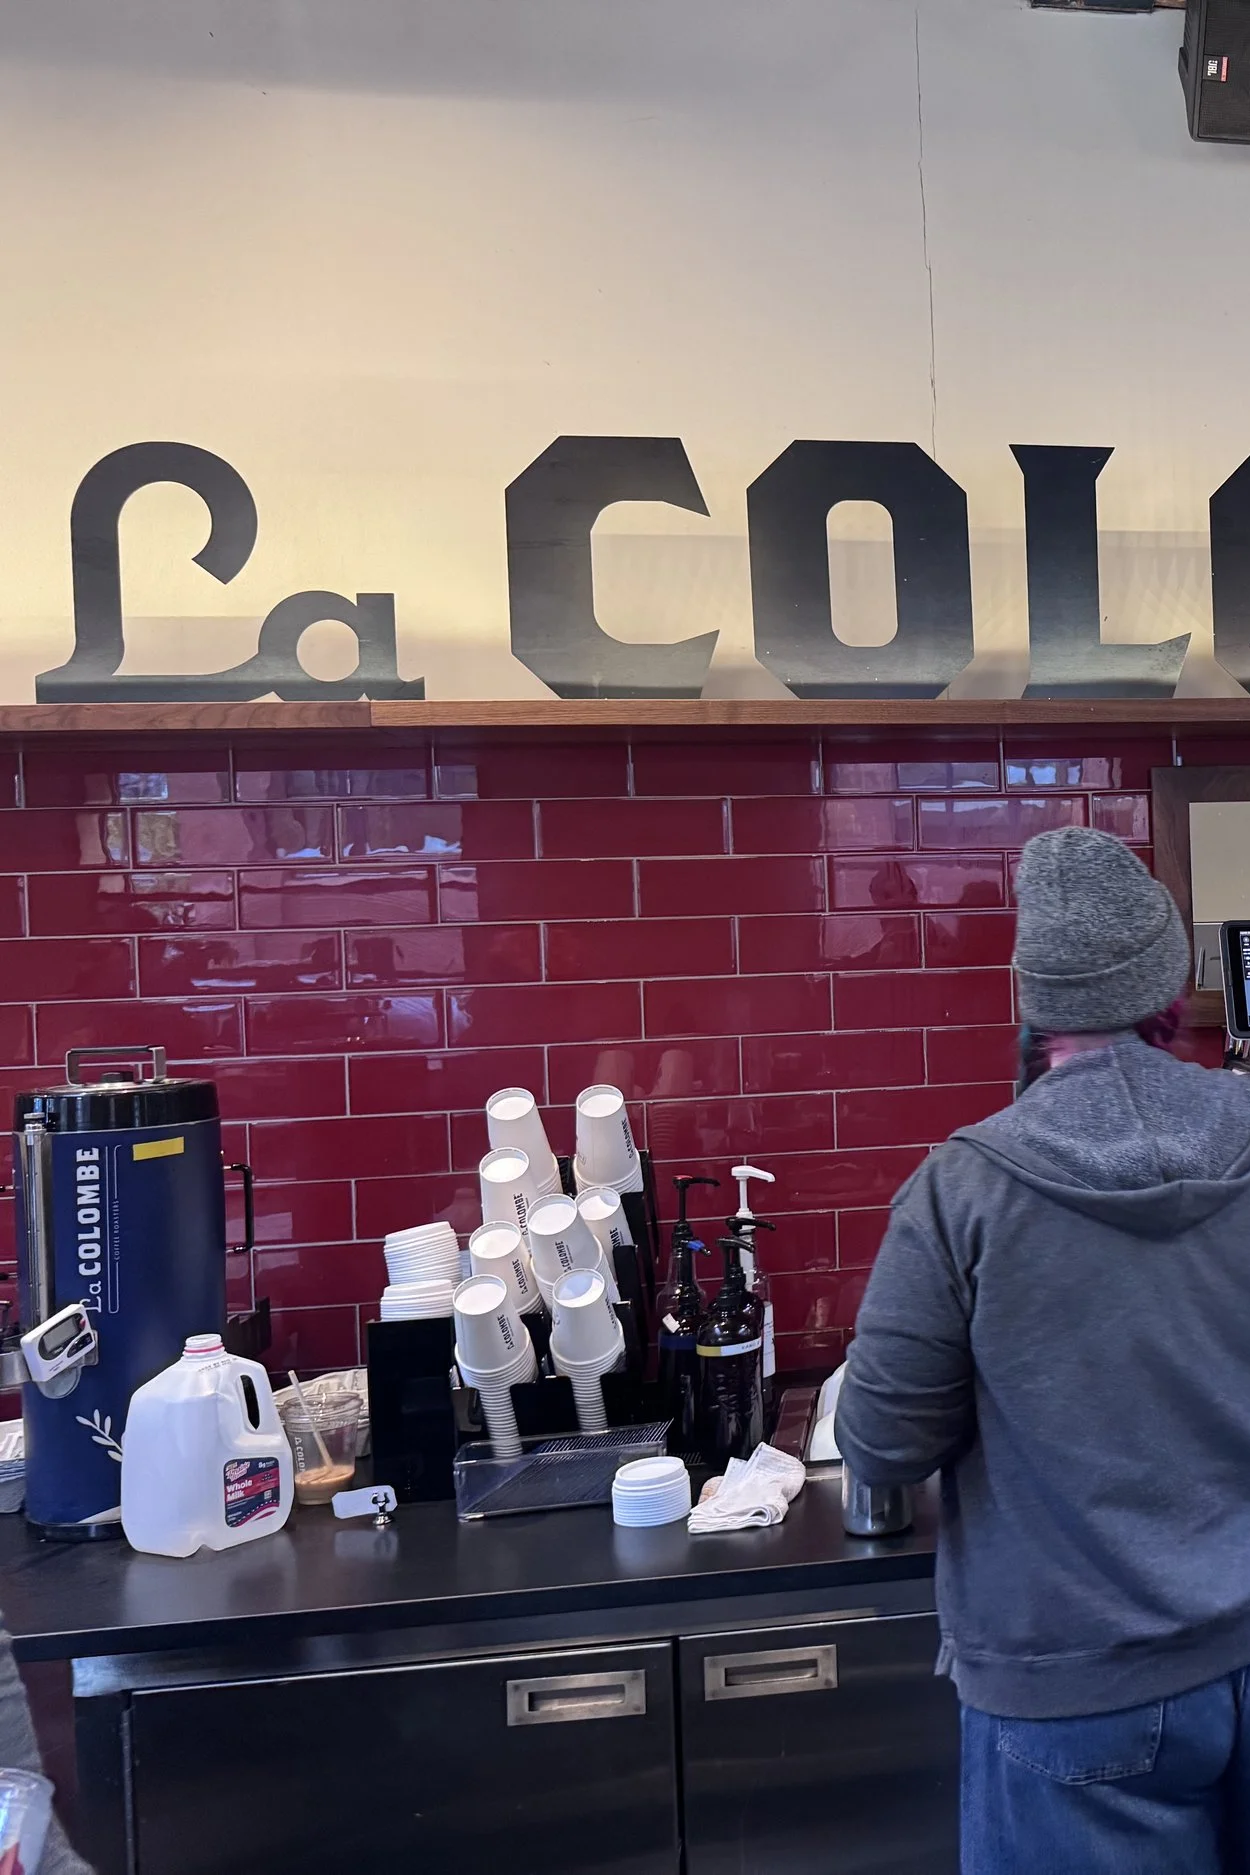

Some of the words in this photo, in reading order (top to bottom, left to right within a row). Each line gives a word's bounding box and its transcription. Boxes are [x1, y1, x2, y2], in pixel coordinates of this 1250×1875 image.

[1207, 60, 1218, 77] JBL
[36, 441, 426, 705] La
[76, 1147, 102, 1276] COLOMBE
[112, 1200, 120, 1235] ROASTERS
[113, 1236, 121, 1261] COFFEE
[555, 1240, 571, 1270] COLOMBE
[511, 1258, 527, 1290] COLOMBE
[497, 1313, 512, 1346] COLOMBE
[226, 1479, 253, 1493] Whole
[226, 1490, 245, 1502] Milk
